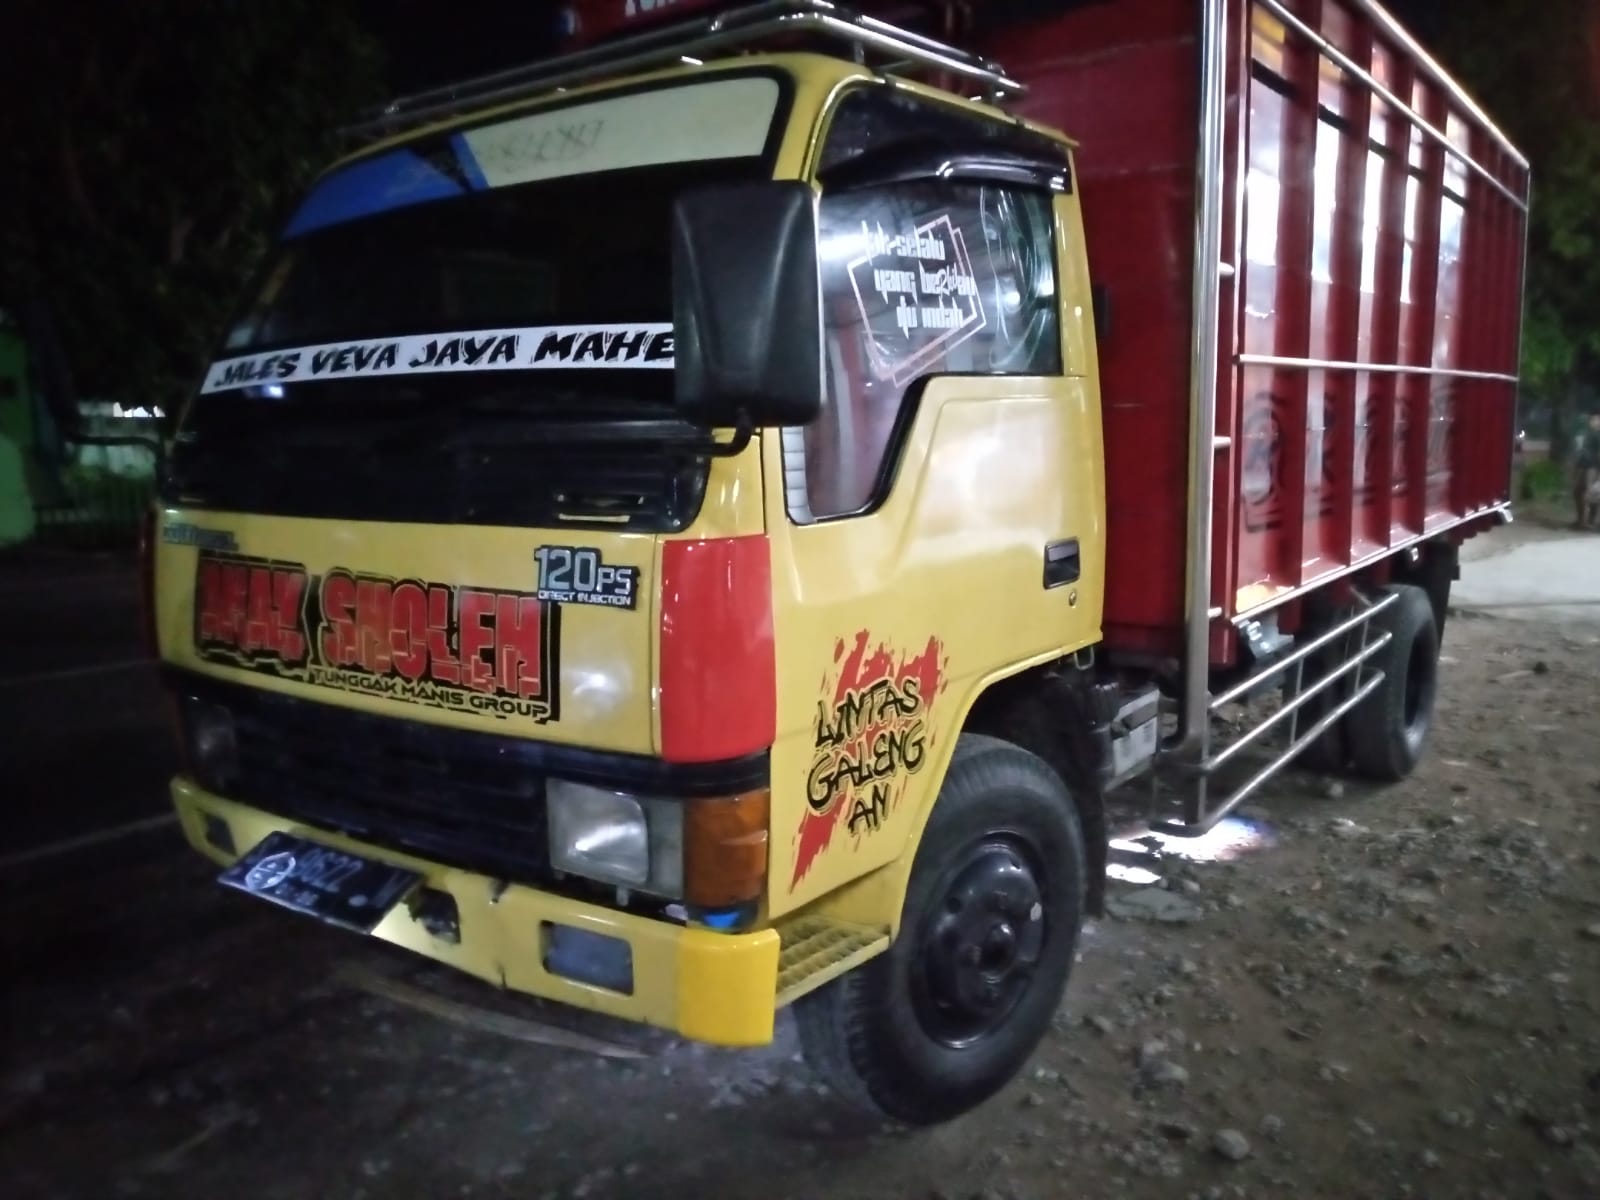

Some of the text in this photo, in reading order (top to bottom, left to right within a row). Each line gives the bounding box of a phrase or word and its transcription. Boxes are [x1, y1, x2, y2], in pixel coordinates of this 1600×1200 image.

[873, 268, 918, 304] yang
[214, 352, 301, 388] JALES
[310, 342, 401, 374] VEVA
[408, 333, 518, 368] JAYA
[538, 589, 632, 606] DIRECT INJECTION
[315, 667, 549, 719] TUNGGAK MANIS GROUP
[814, 678, 920, 746] LINTAS
[807, 720, 925, 811] GALENG
[848, 784, 890, 834] AN
